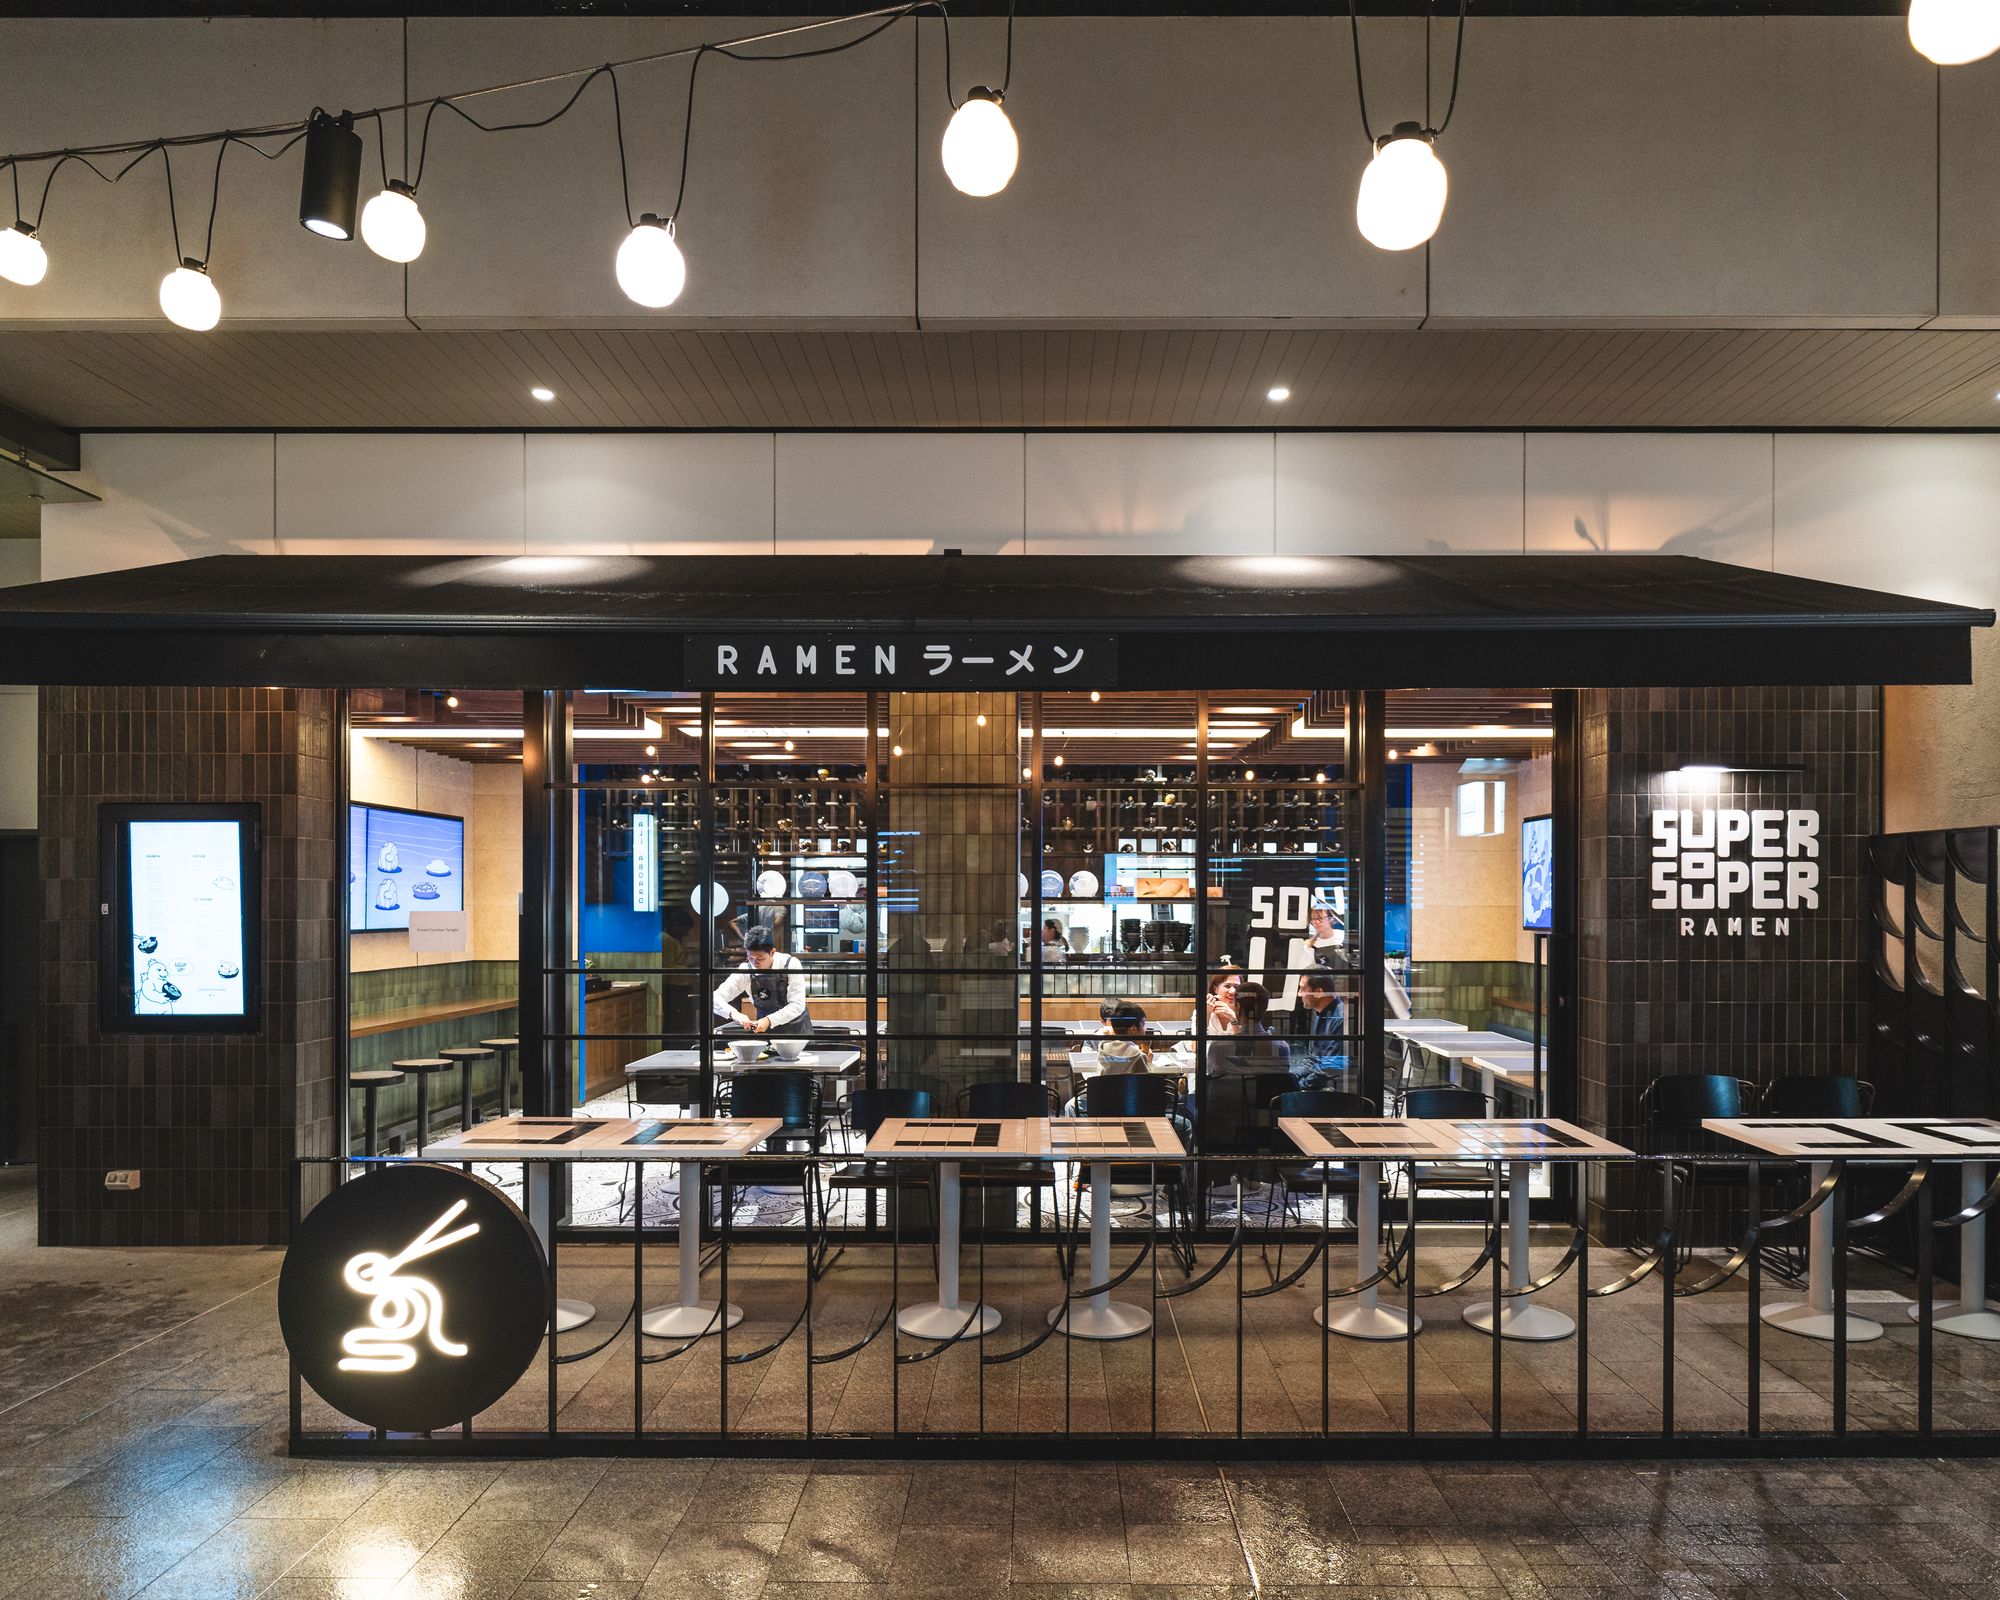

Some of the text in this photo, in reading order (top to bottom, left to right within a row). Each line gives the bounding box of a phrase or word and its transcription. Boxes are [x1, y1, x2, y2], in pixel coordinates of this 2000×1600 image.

[716, 644, 897, 676] RAMEN
[922, 644, 1085, 676] ラーメン
[1652, 809, 1820, 858] SUPER
[1680, 917, 1790, 936] RAMEN
